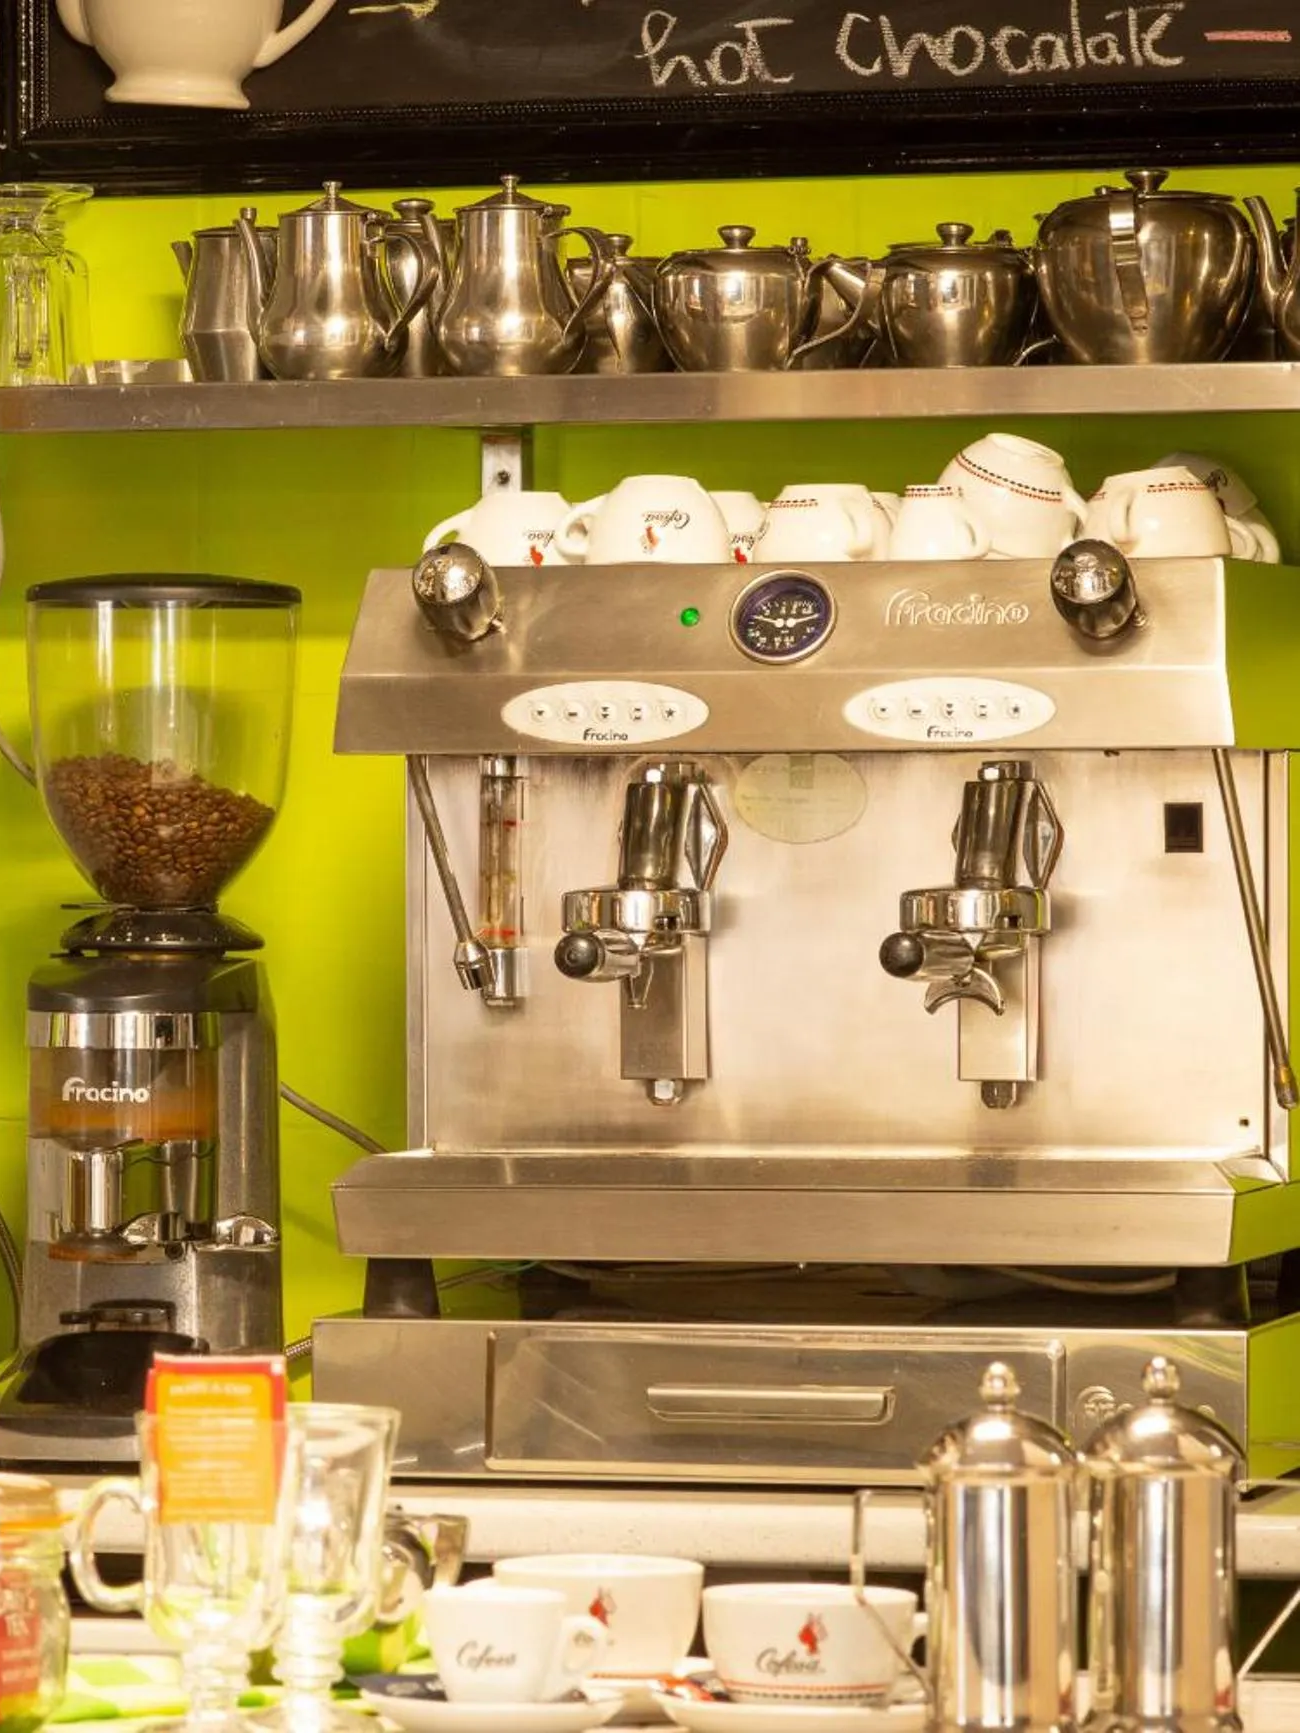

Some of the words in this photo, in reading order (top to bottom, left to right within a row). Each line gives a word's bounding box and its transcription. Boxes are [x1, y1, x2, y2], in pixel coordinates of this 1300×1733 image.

[634, 10, 795, 88] hot
[583, 728, 629, 742] Fracino
[926, 725, 973, 739] Fracino
[61, 1076, 150, 1103] Fracino
